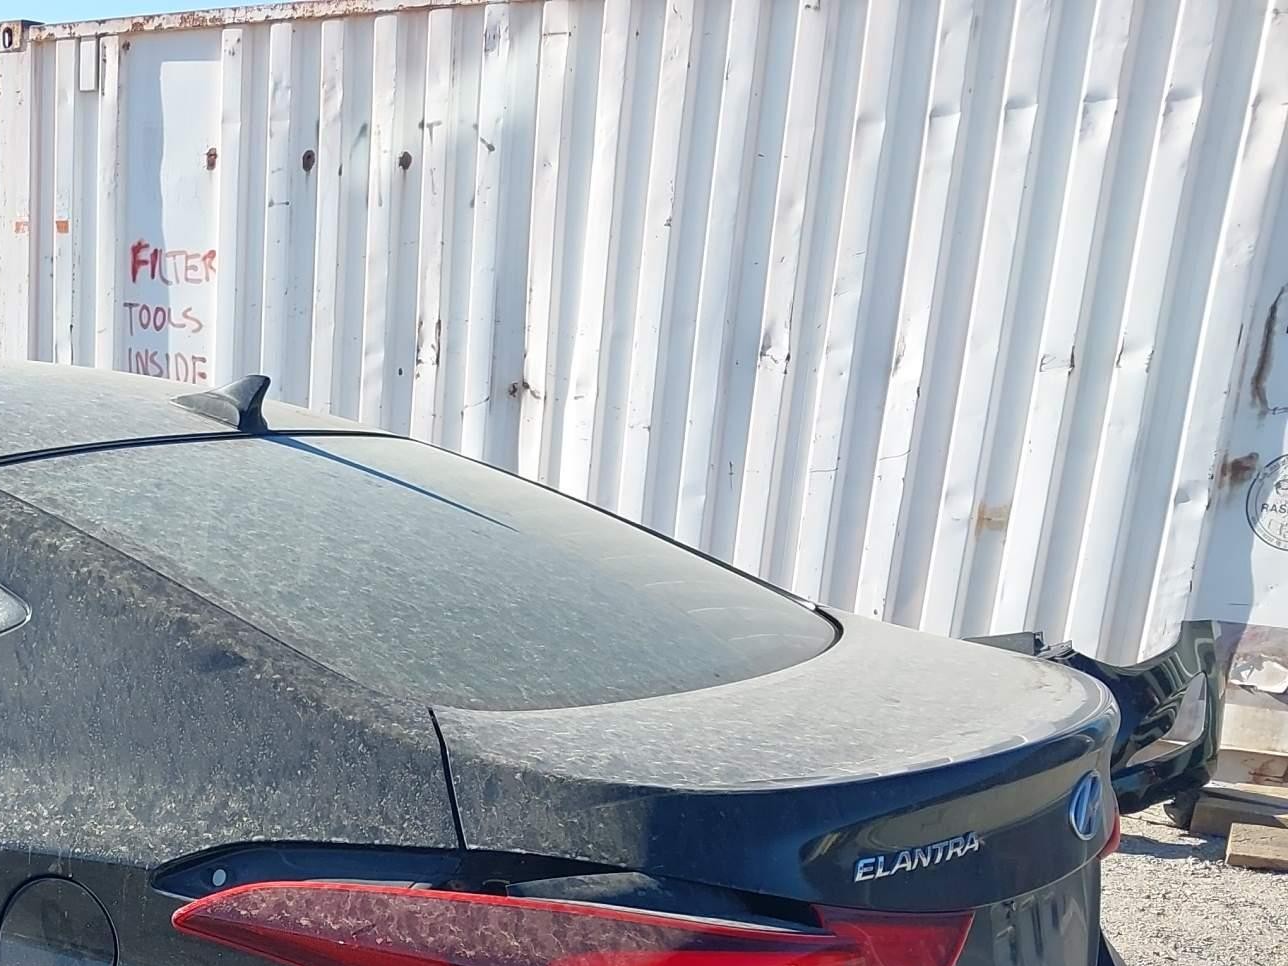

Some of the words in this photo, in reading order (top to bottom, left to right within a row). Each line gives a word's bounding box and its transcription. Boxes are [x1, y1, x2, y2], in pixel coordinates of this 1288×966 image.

[130, 238, 216, 284] FILTER
[123, 302, 204, 336] TOOLS
[129, 347, 208, 384] INSIDE
[853, 831, 980, 883] ELANTRA
